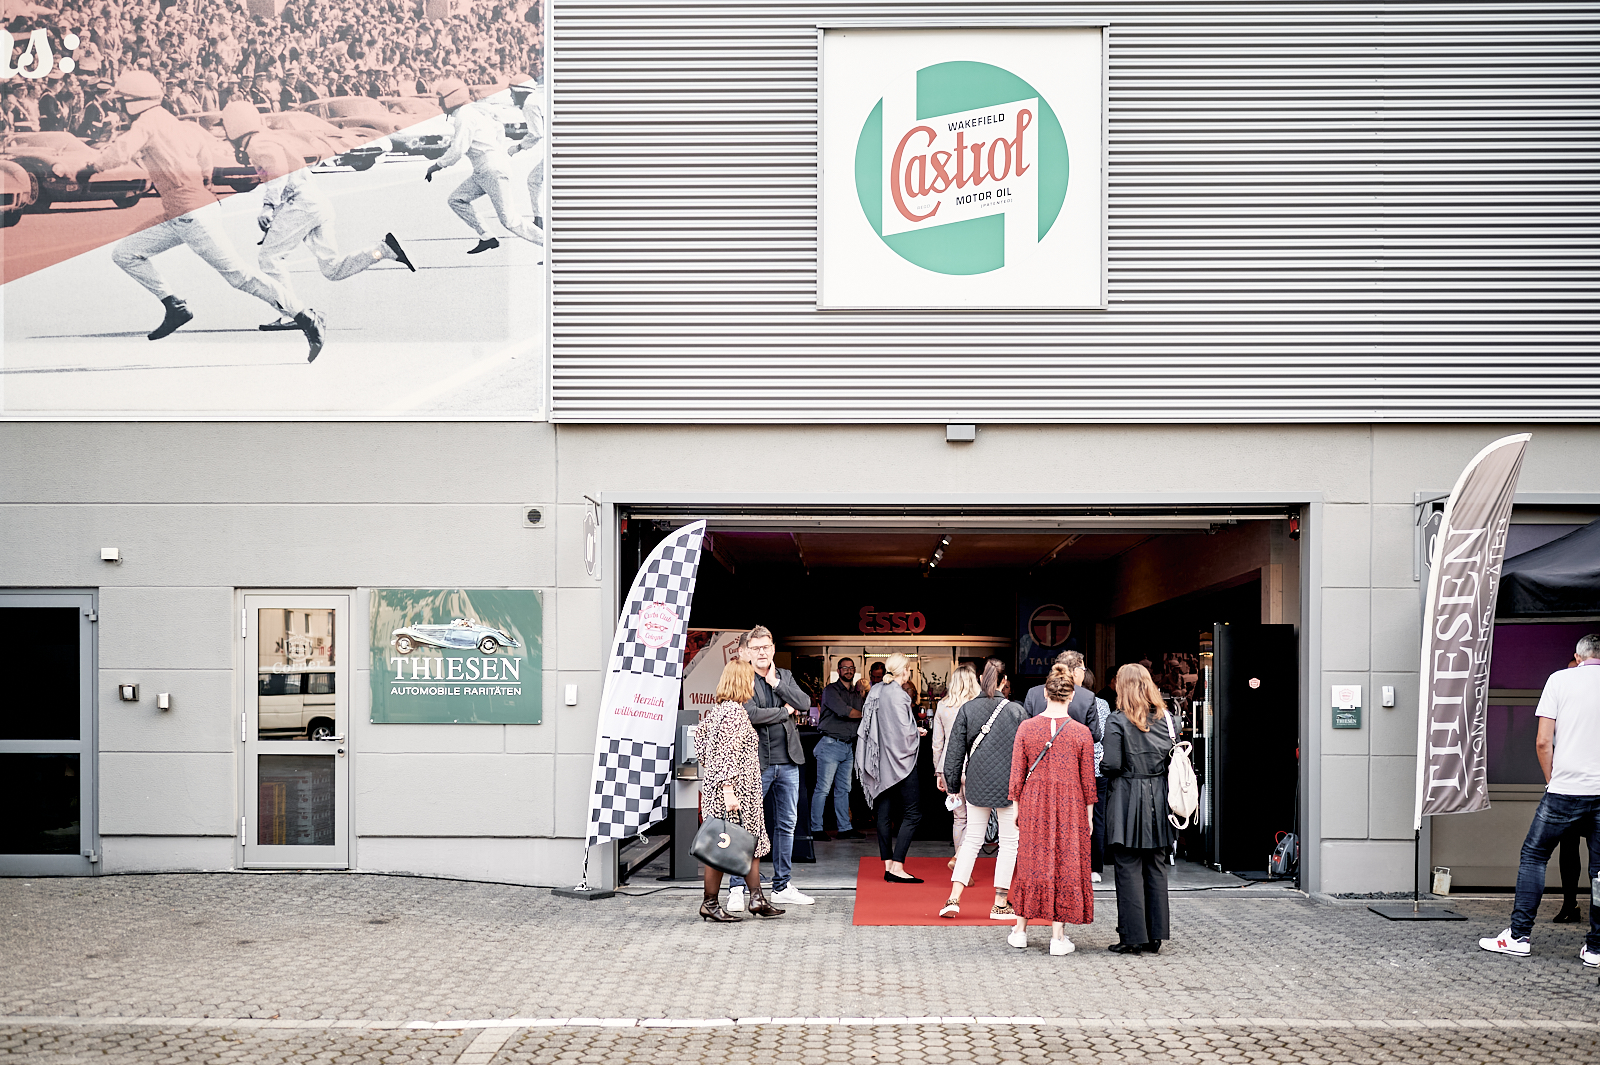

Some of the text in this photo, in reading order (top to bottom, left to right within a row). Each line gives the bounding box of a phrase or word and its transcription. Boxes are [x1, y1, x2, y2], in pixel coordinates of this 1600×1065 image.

[947, 113, 1005, 132] WAKEFIELD
[890, 108, 1033, 222] Castrol
[955, 187, 1012, 206] MOTOR OIL
[272, 659, 324, 674] Corner
[390, 656, 522, 681] THIESEN
[1425, 524, 1487, 802] THIESEN
[390, 685, 522, 696] AUTOMOBILE RARITÄTEN
[689, 692, 717, 705] Willk
[633, 693, 665, 708] Herzlich
[614, 706, 664, 722] willkommen
[1496, 938, 1508, 949] N
